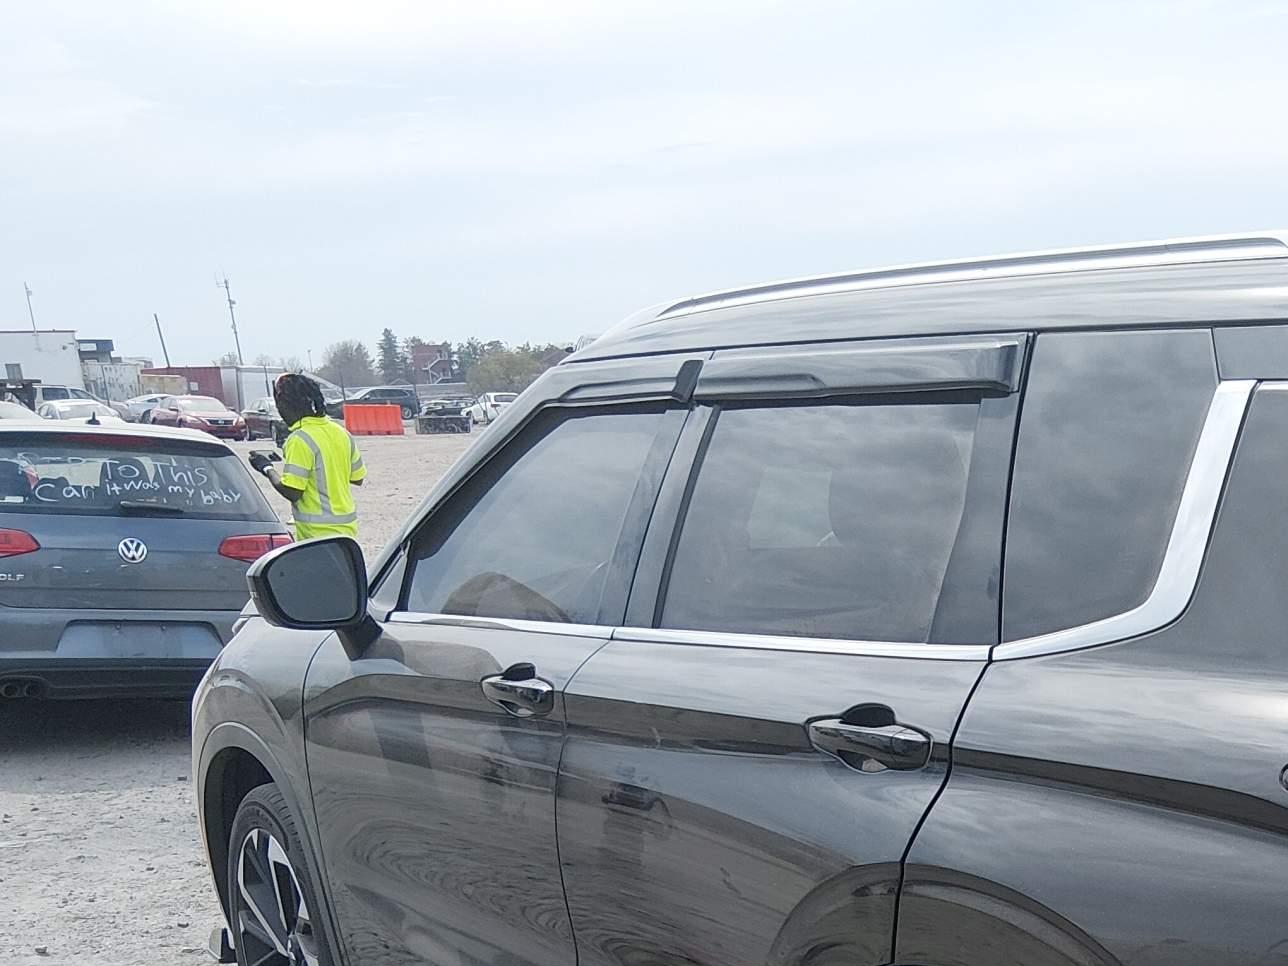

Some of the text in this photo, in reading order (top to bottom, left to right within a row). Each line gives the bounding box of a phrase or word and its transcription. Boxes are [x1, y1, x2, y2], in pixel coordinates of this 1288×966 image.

[99, 459, 140, 480] To
[151, 457, 209, 486] This
[168, 485, 195, 498] my
[200, 489, 241, 505] baby
[0, 573, 25, 581] OLF
